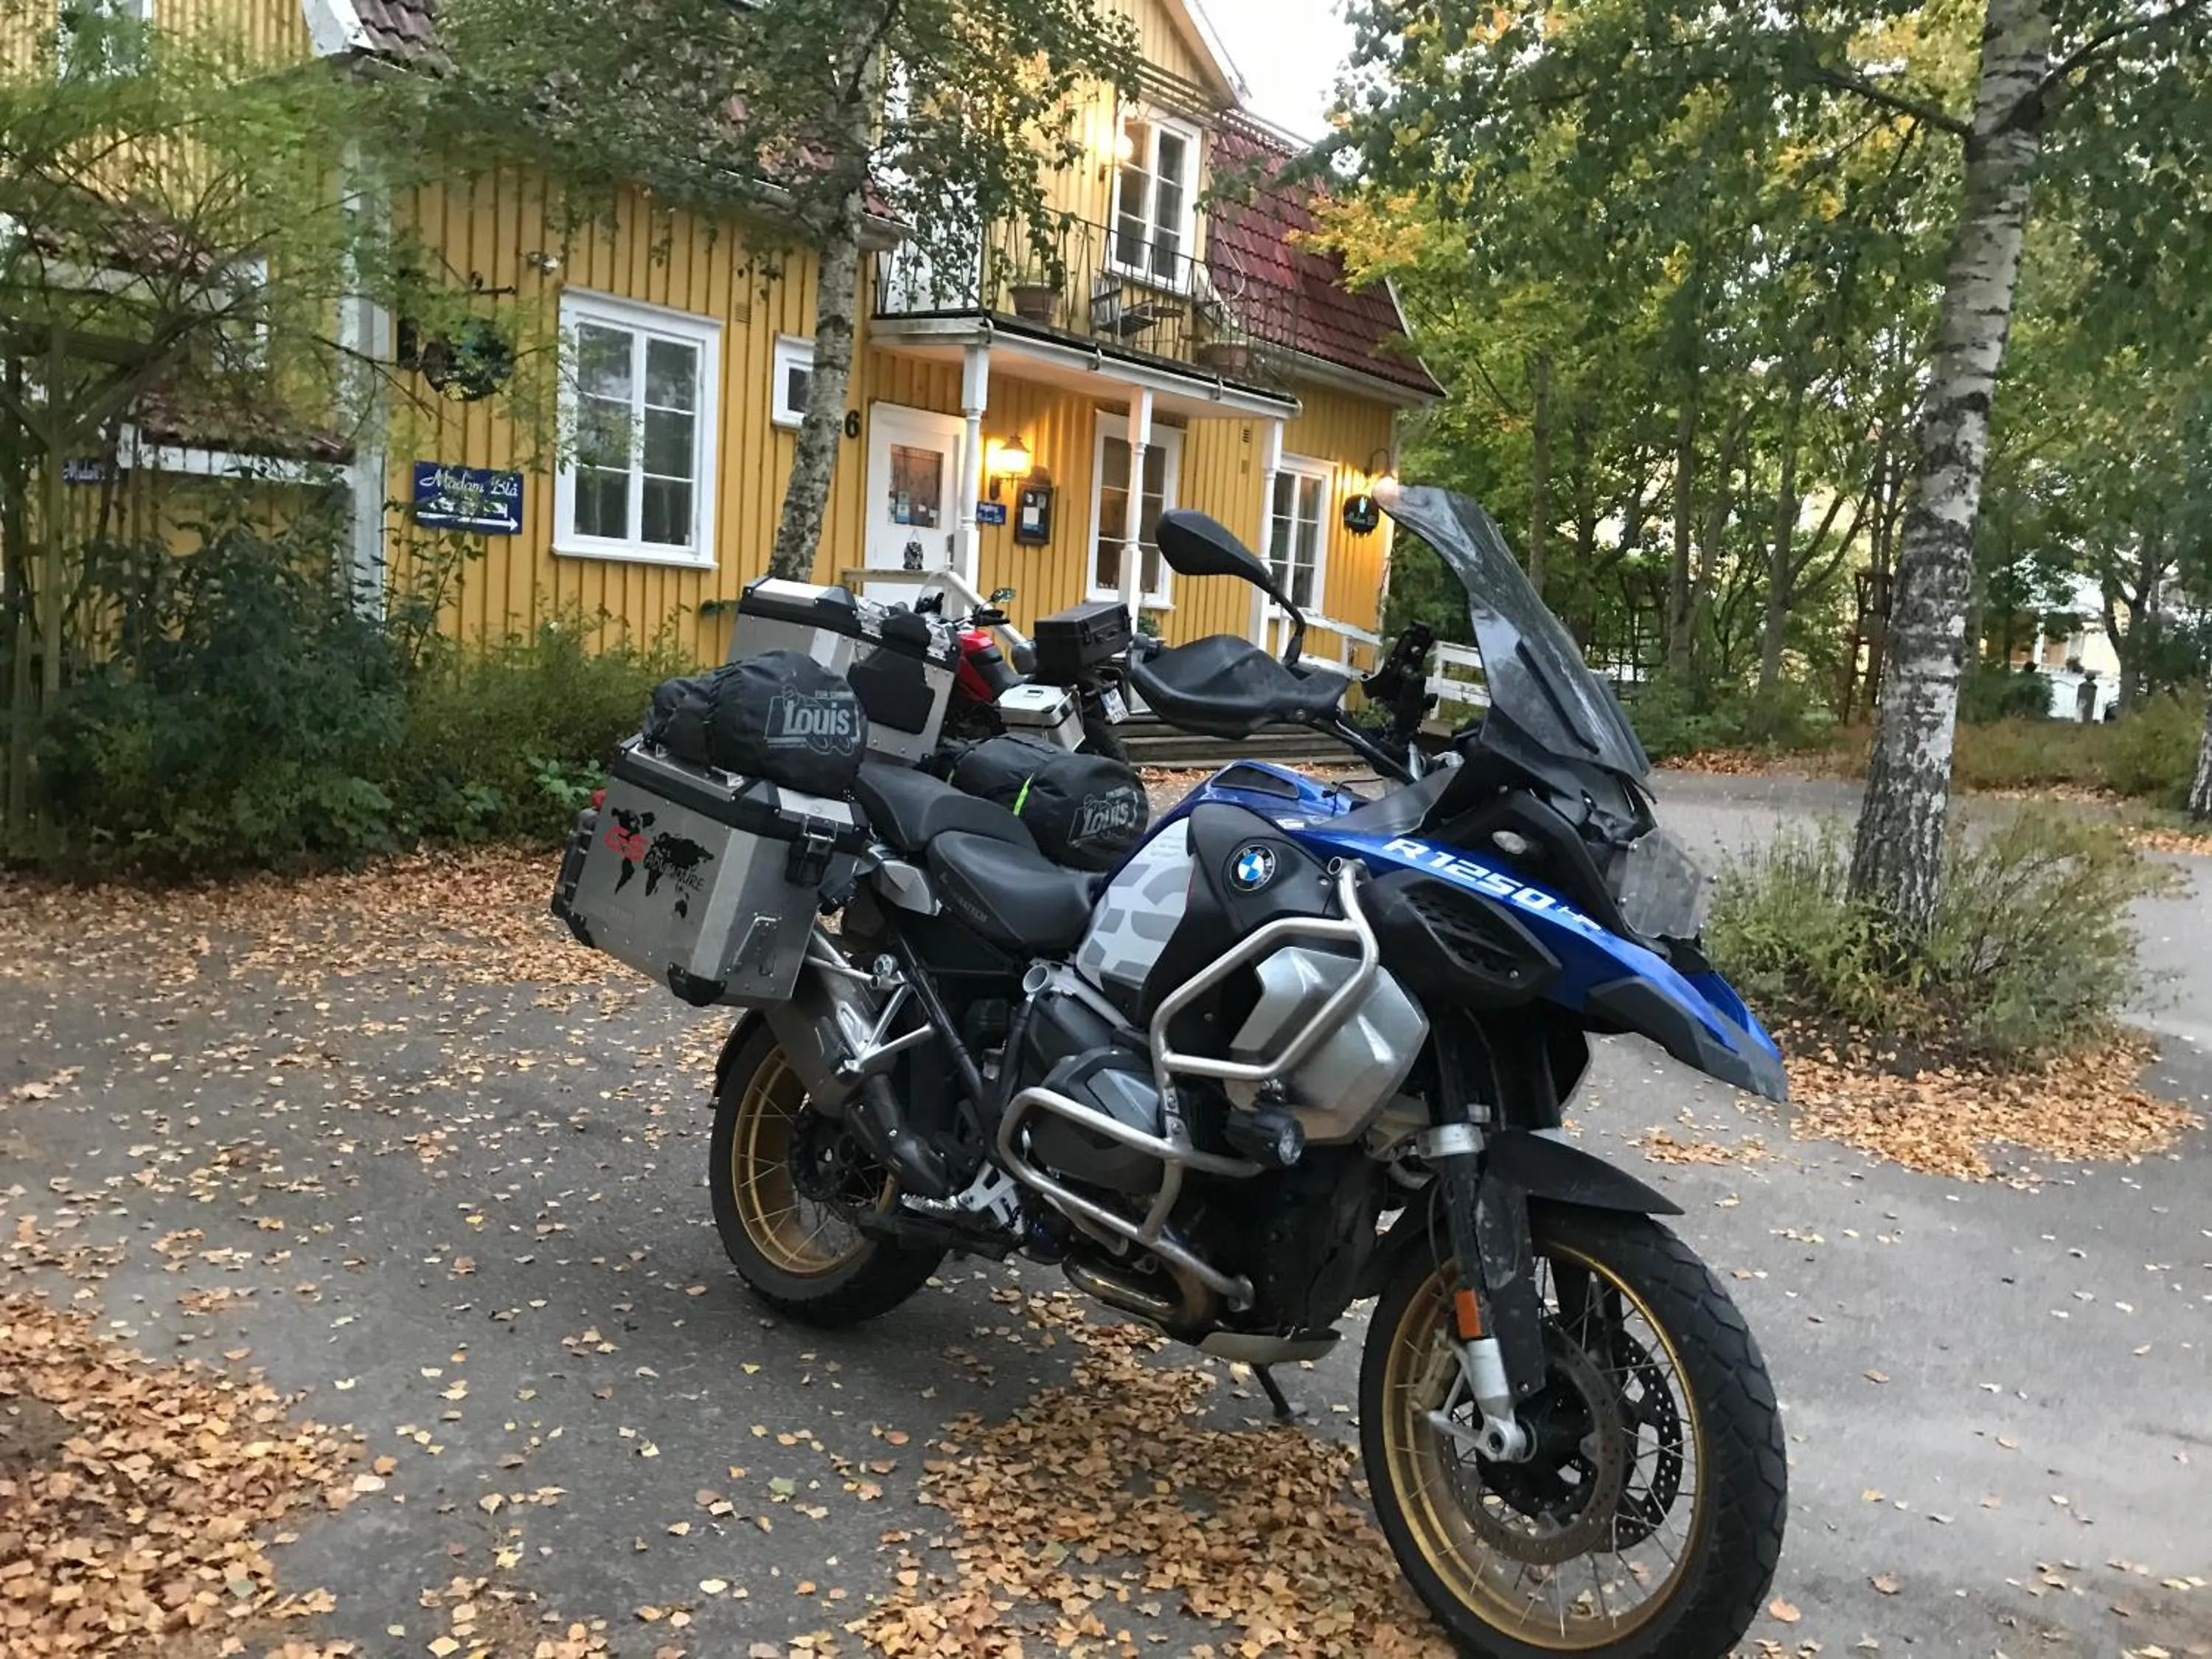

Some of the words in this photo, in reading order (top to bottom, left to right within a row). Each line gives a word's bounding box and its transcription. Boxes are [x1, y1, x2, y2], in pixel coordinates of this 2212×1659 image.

[844, 410, 860, 439] 6
[419, 468, 484, 493] Madam
[782, 695, 851, 736] Louis
[1080, 799, 1129, 836] Louis
